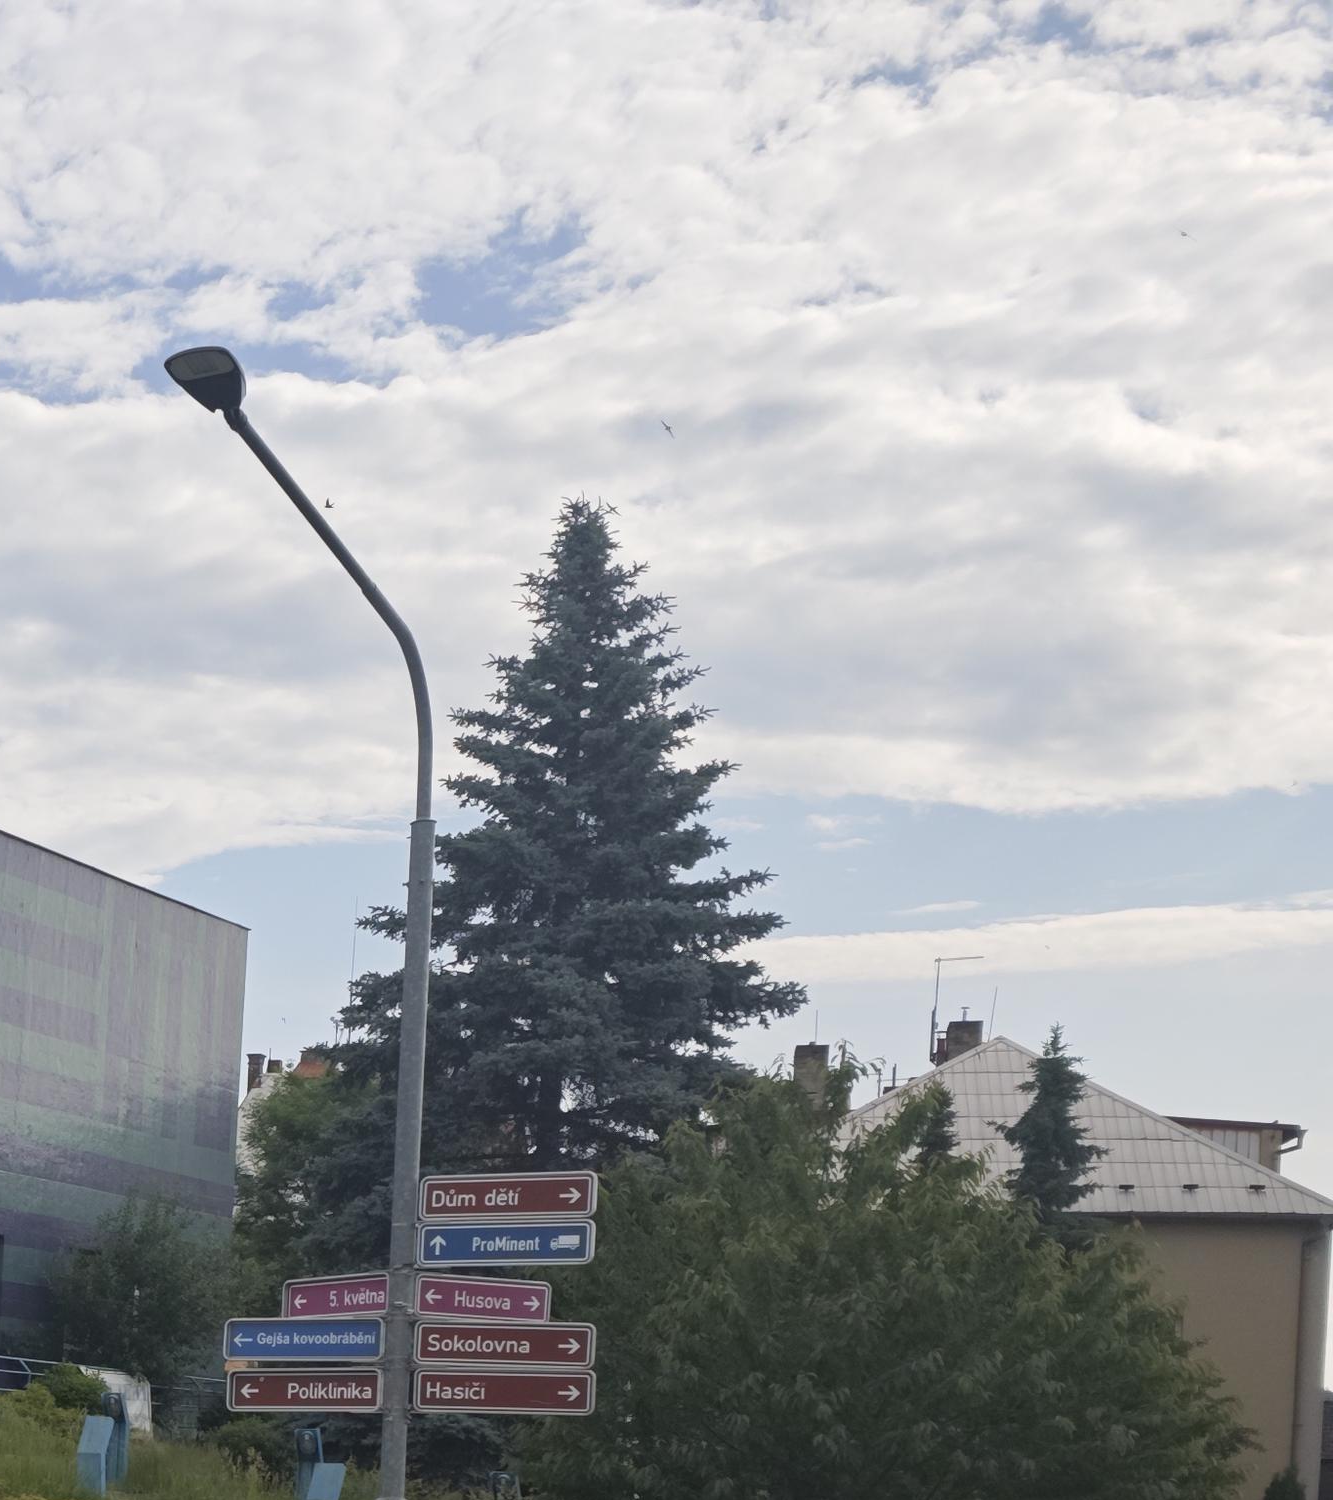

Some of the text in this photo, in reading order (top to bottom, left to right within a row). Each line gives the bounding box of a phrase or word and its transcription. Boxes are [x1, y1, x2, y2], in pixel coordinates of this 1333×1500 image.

[431, 1187, 522, 1208] Dům dětí
[471, 1235, 540, 1252] ProMinent
[329, 1287, 386, 1308] 5. května
[454, 1290, 511, 1310] Husova
[256, 1331, 376, 1347] Gejša kovoobrábění
[427, 1334, 531, 1354] Sokolovna
[287, 1382, 372, 1400] Poliklinika
[425, 1381, 486, 1400] Hasiči
